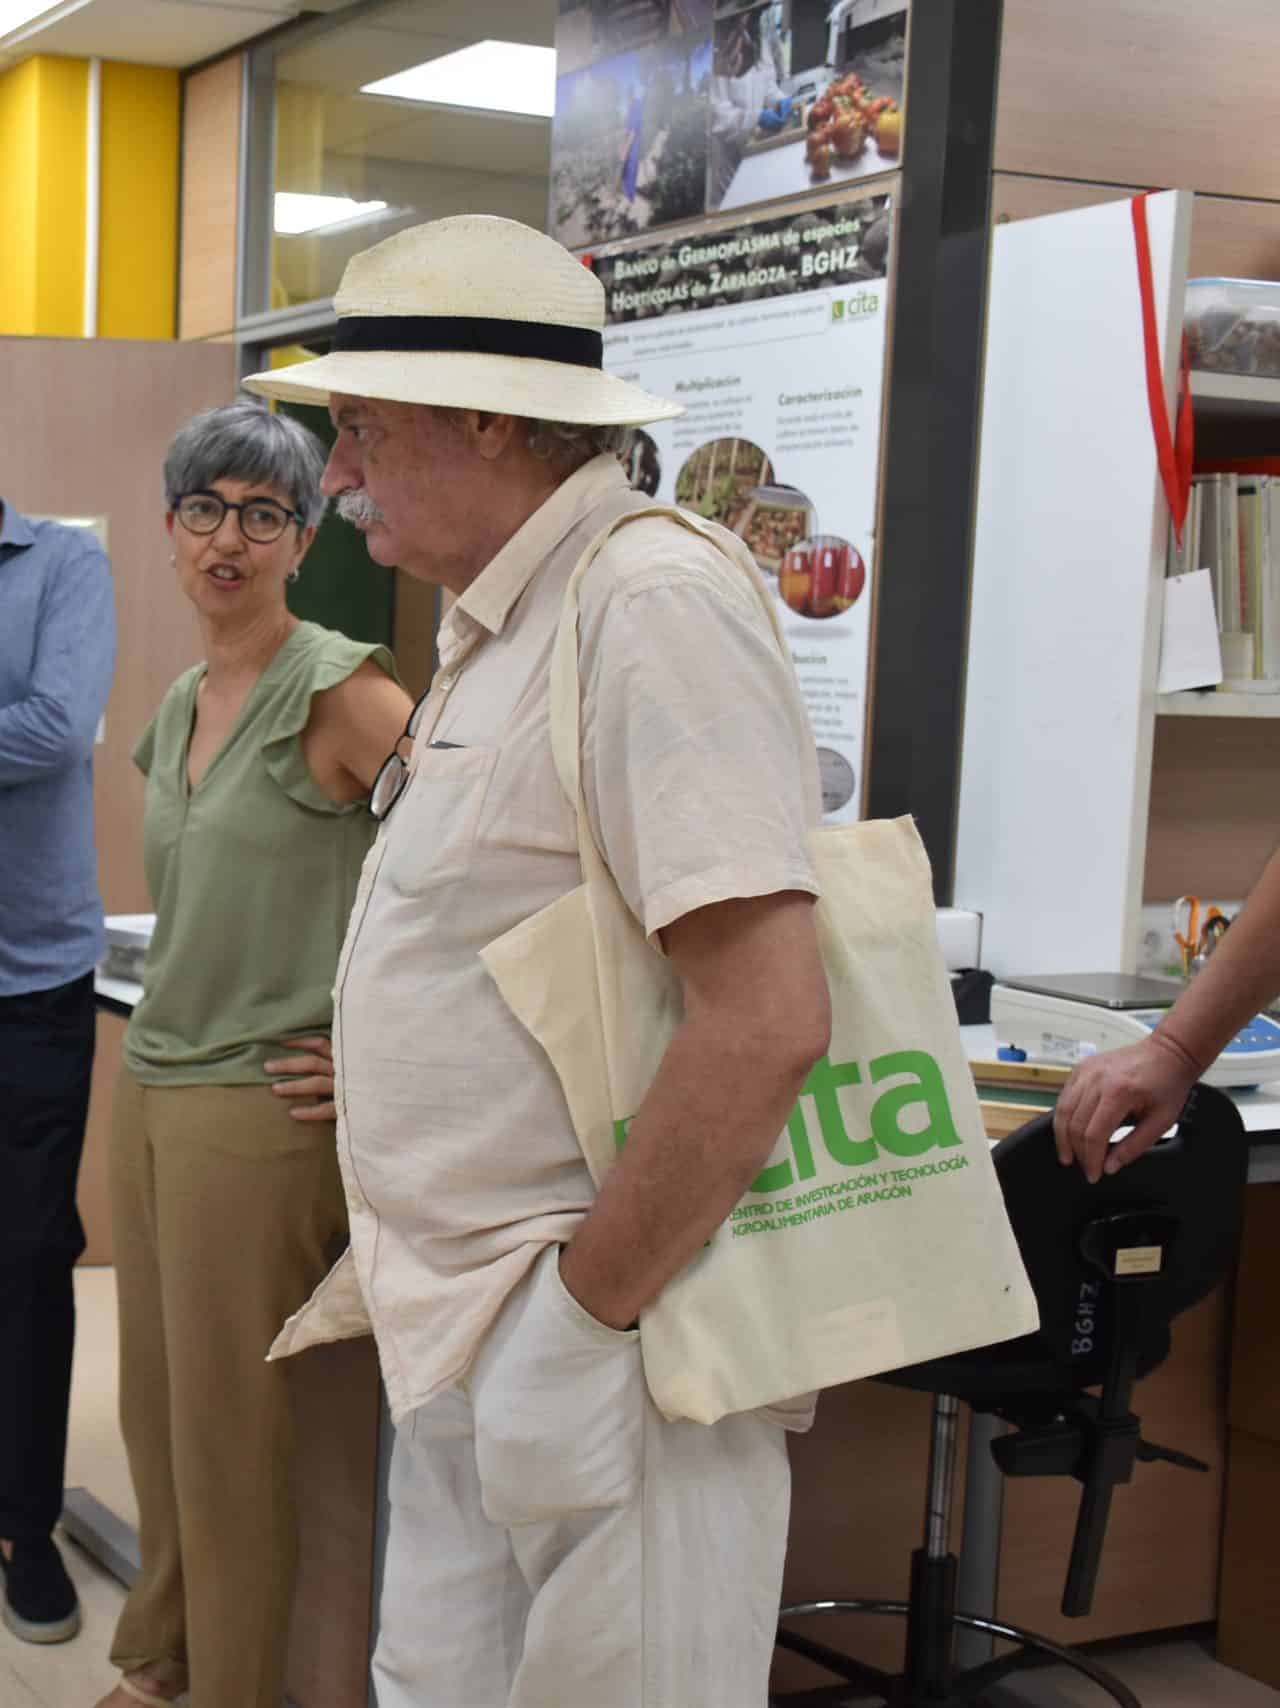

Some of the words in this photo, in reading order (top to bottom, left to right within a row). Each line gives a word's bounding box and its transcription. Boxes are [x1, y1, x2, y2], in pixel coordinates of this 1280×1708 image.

[782, 228, 800, 245] de
[803, 217, 860, 243] especies
[709, 265, 787, 294] ZARAGOZA
[801, 245, 860, 277] BGHZ
[848, 289, 879, 316] cita
[775, 1198, 794, 1213] DE
[880, 1171, 888, 1185] Y
[889, 1153, 969, 1182] TECNOLOGÍA
[838, 1196, 855, 1211] DE
[857, 1183, 913, 1207] ARAGÓN
[1071, 1281, 1098, 1355] BGHZ
